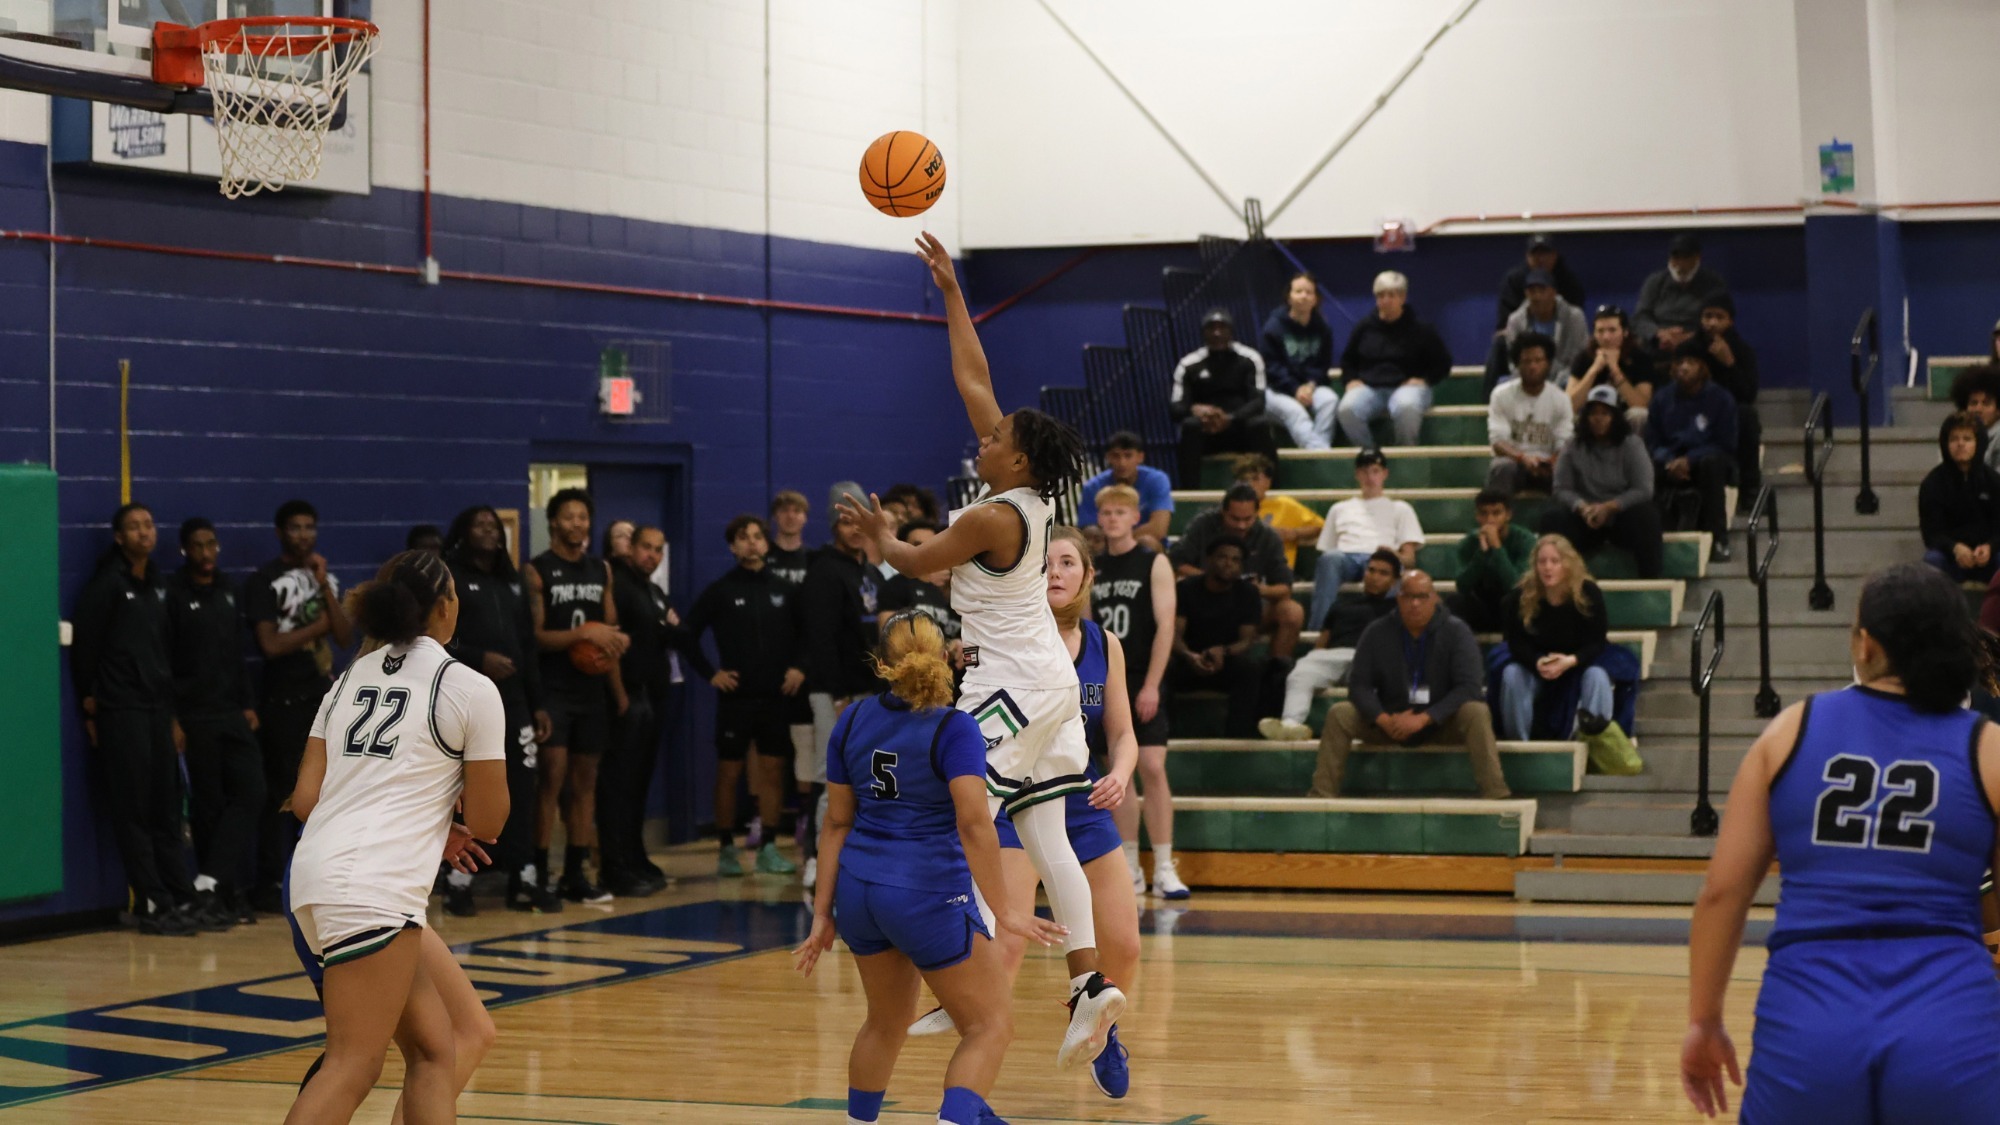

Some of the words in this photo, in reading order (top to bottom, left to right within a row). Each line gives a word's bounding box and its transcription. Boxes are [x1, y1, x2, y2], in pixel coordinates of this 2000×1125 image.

[1099, 604, 1129, 639] 20
[343, 685, 412, 760] 22
[870, 749, 899, 798] 5
[1811, 752, 1940, 854] 22
